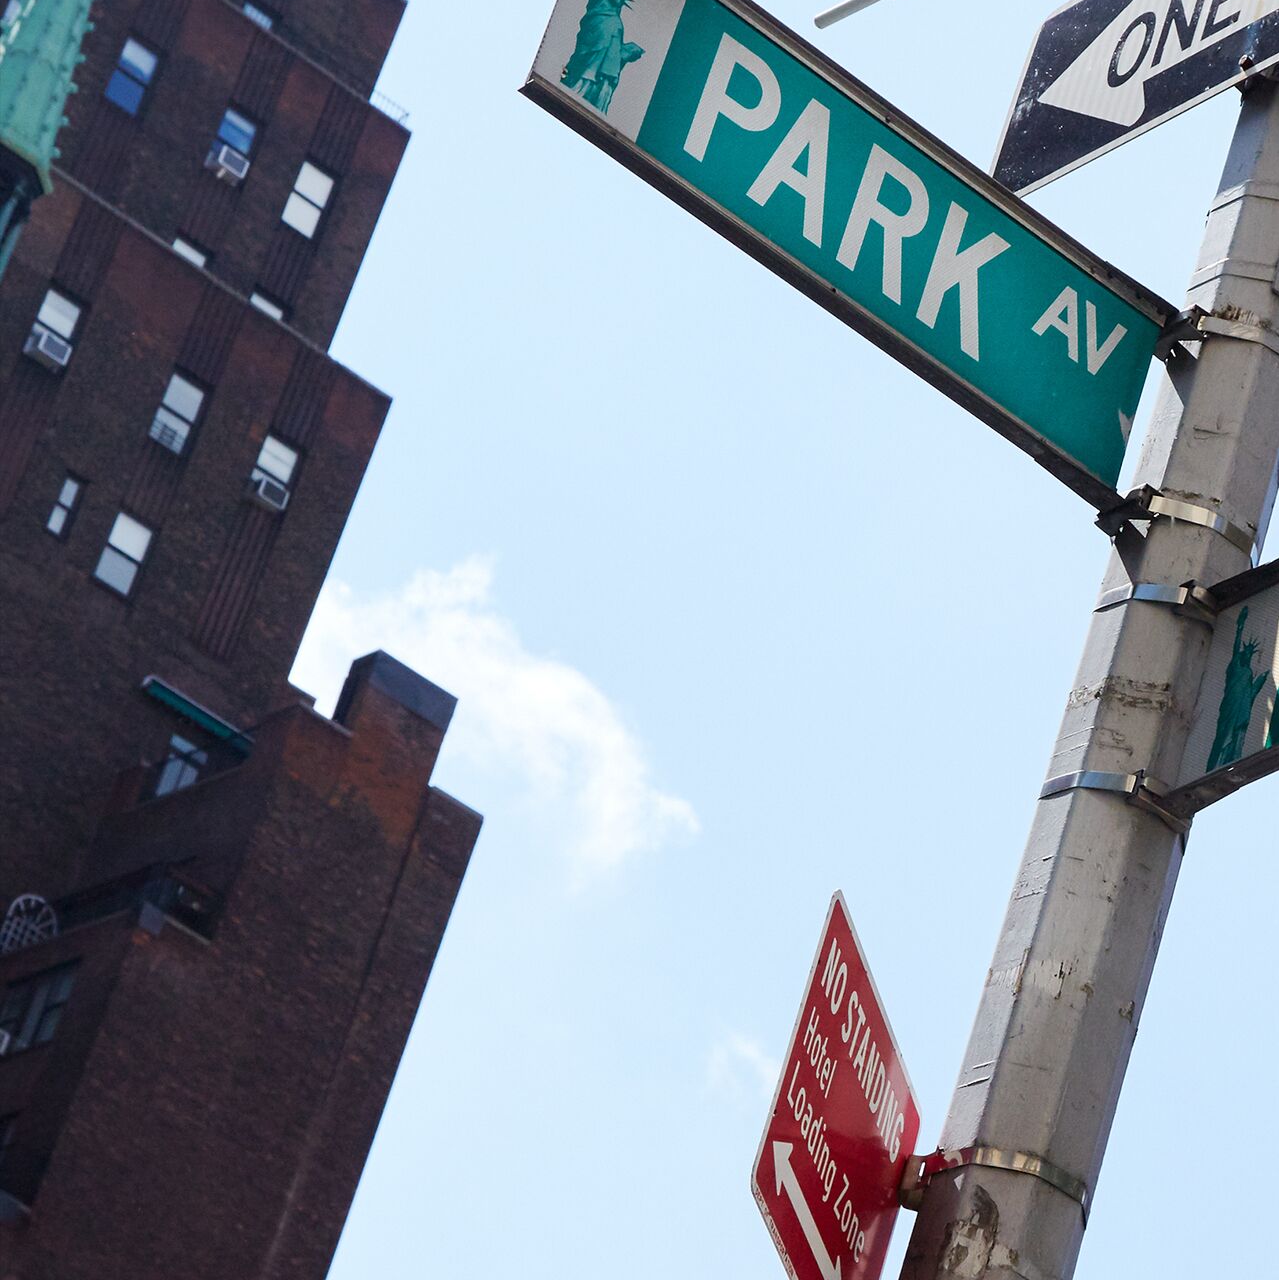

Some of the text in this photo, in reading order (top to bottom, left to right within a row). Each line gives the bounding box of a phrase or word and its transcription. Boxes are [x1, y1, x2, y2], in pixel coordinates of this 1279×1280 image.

[682, 31, 1127, 376] PARK AV
[803, 1006, 838, 1099] Hotel
[820, 937, 905, 1164] NO STANDING
[787, 1060, 865, 1264] Loading Zone
